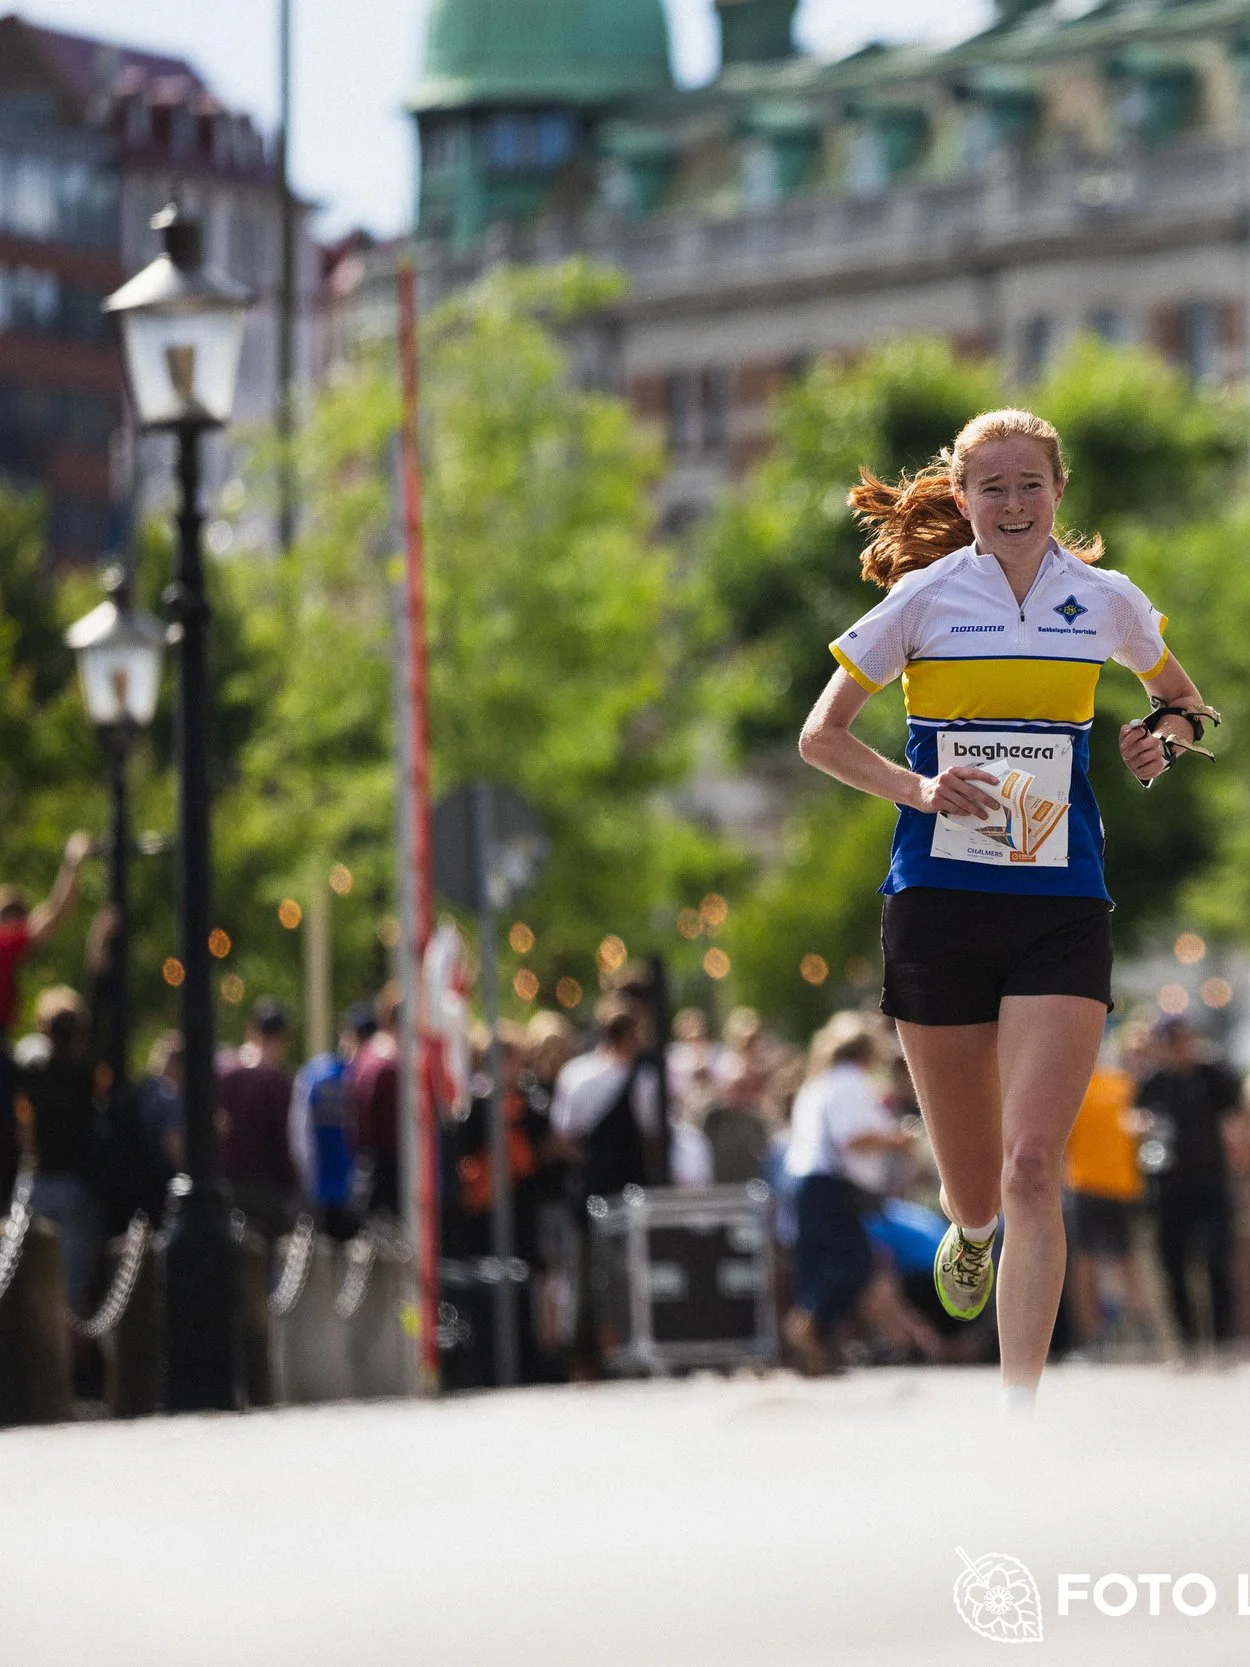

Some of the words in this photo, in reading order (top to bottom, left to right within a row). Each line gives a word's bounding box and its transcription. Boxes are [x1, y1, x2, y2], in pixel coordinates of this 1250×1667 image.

[950, 625, 1005, 633] noname
[954, 742, 1054, 760] bagheera
[967, 847, 1003, 858] CHALMERS
